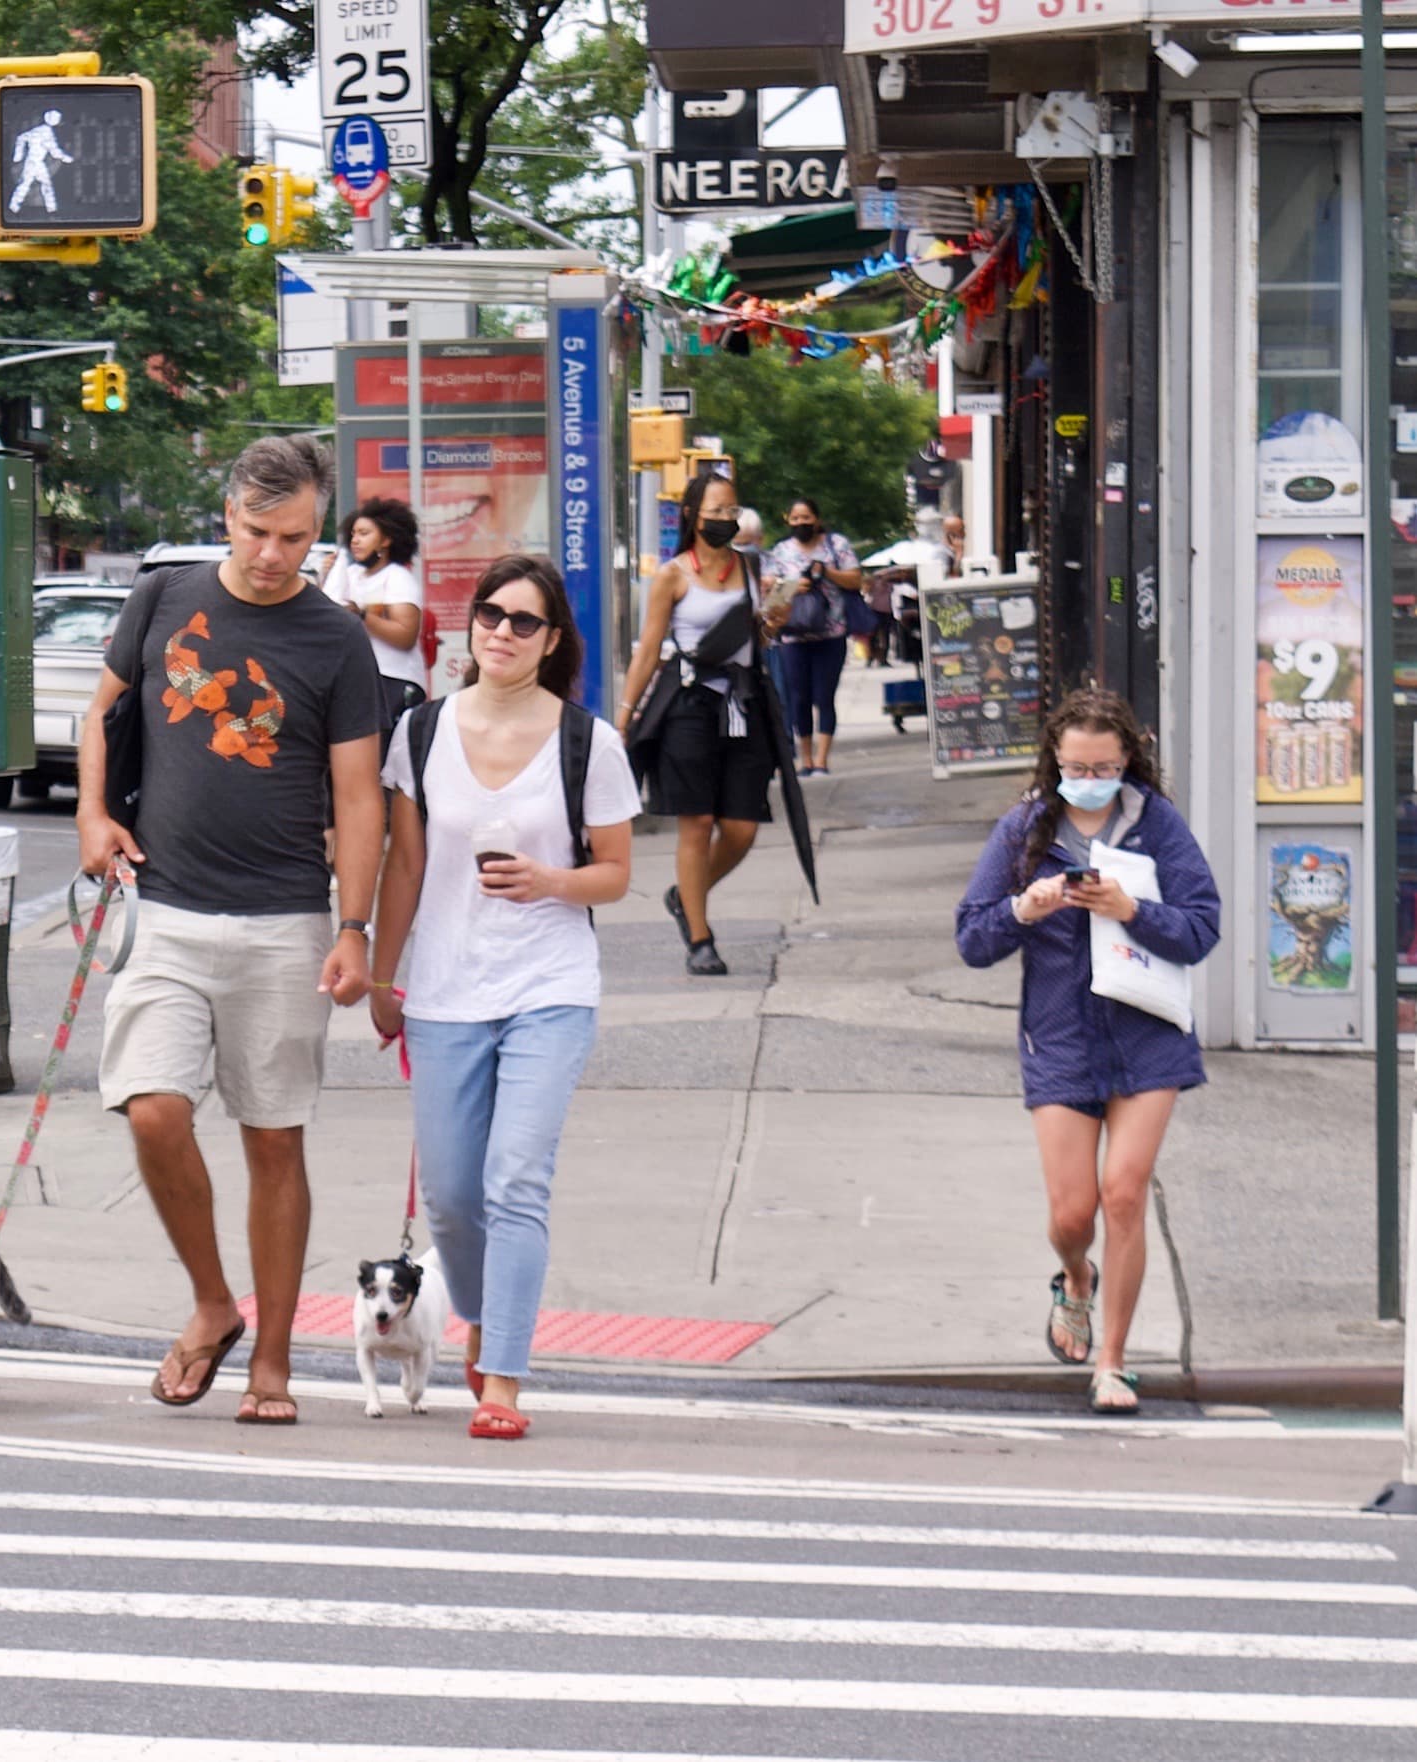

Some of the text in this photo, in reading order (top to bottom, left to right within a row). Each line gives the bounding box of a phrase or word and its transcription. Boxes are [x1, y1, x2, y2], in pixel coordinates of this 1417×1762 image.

[338, 0, 398, 18] SPEED
[344, 24, 392, 42] LIMIT
[335, 50, 411, 105] 25
[662, 158, 851, 203] NEERGA
[390, 374, 445, 387] Impving
[485, 371, 517, 386] Every
[520, 370, 543, 383] Day
[427, 450, 543, 464] Diamond Braces
[563, 337, 590, 572] 5 Avenue & 9 Street
[1276, 567, 1343, 582] MEDALLA
[1273, 639, 1340, 701] $9
